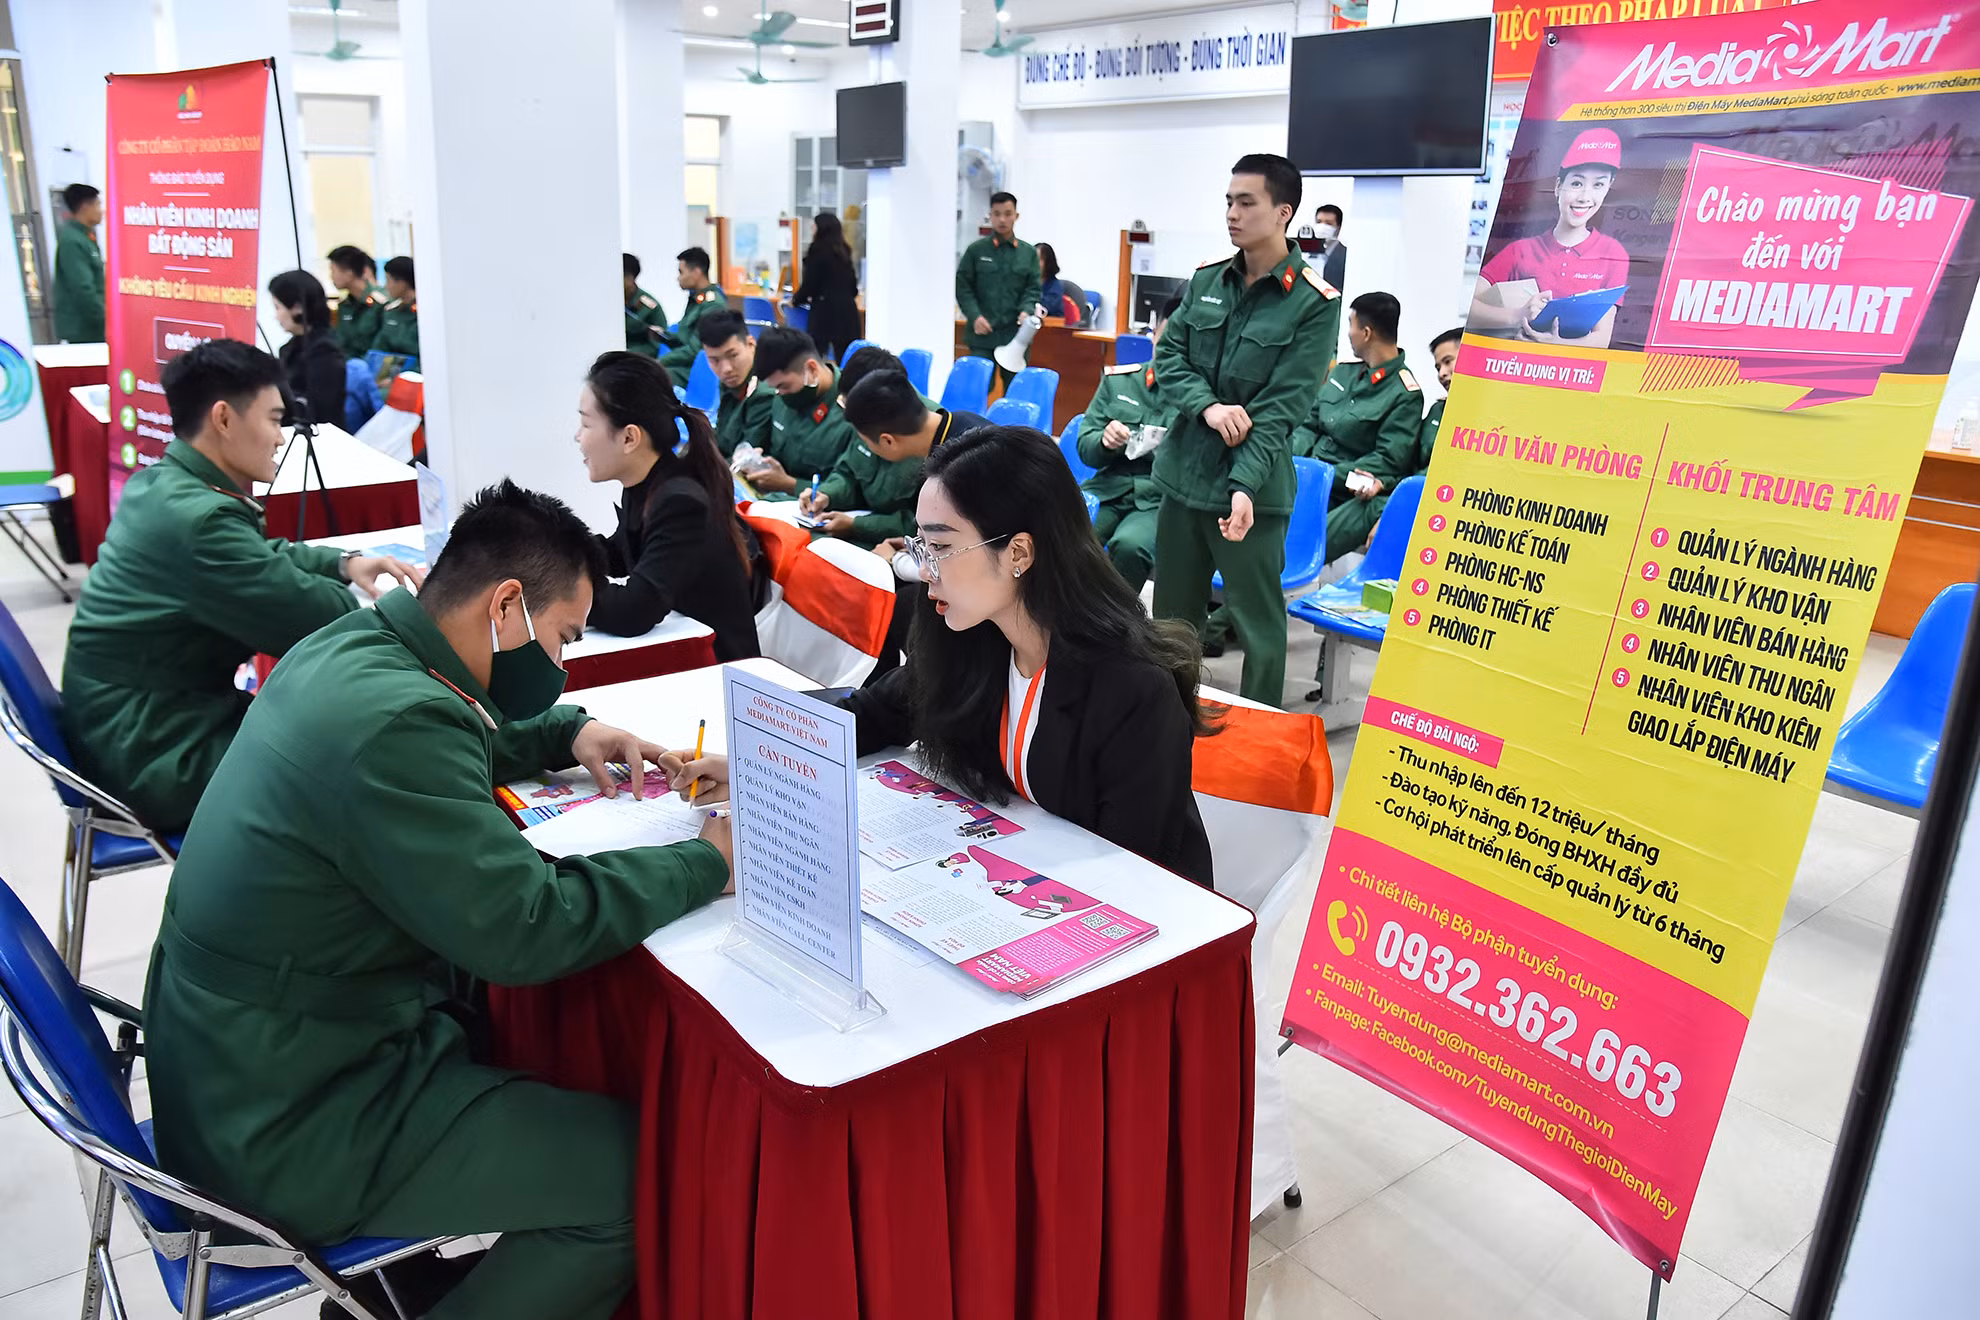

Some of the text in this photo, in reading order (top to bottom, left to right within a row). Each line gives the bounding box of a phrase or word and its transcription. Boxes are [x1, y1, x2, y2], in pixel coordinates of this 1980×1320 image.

[1605, 15, 1952, 92] Media Mart
[1581, 107, 1592, 116] Hệ
[1594, 105, 1618, 118] thống
[1619, 106, 1636, 114] hơn
[1637, 104, 1655, 113] 300
[1675, 103, 1687, 112] thị
[1688, 102, 1709, 111] Điện
[1712, 99, 1732, 110] Máy
[1733, 96, 1788, 107] MediaMart
[1788, 94, 1809, 106] phủ
[1811, 92, 1834, 103] sóng
[1836, 88, 1859, 98] toàn
[1861, 83, 1888, 96] quốc
[1697, 180, 1938, 232] Chào mừng bạn
[1742, 231, 1845, 270] đến với
[1670, 279, 1913, 334] MEDIAMART
[1485, 356, 1594, 384] TUYỂN DỤNG VỊ TRÍ:
[1451, 426, 1643, 480] KHỐI VĂN PHÒNG
[1462, 488, 1609, 536] PHÒNG KINH DOANH
[1667, 459, 1900, 522] KHỐI TRUNG TÂM
[1445, 552, 1545, 594] PHÒNG HC-NS
[1453, 520, 1570, 564] PHÒNG KẾ TOÁN
[1678, 528, 1877, 591] QUẢN LÝ NGÀNH HÀNG
[1436, 583, 1560, 632] PHÒNG THIẾT KẾ
[1668, 565, 1832, 625] QUẢN LÝ KHO VẬN
[1428, 615, 1496, 650] PHÒNG IT
[1657, 603, 1848, 672] NHÂN VIÊN BÁN HÀNG
[1647, 639, 1836, 712] NHÂN VIÊN THU NGÂN
[1391, 711, 1479, 754] CHẾ ĐỘ ĐÃI NGỘ:
[1637, 675, 1822, 752] NHÂN VIÊN KHO KIÊM
[1628, 710, 1796, 784] GIAO LẮP ĐIỆN MÁY
[1399, 745, 1660, 866] Thu nhập lên đến 12 triệu/ tháng
[1390, 772, 1679, 903] Đào tạo kỹ năng, Đóng BHXH đầy đủ
[1383, 798, 1725, 964] Cơ hội phát triển lên cấp quản lý từ 6 tháng
[1350, 867, 1619, 1010] Chi tiết liên hệ Bộ phận tuyển dụng:
[1375, 921, 1682, 1117] 0932.362.663
[1321, 963, 1614, 1139] Email: Tuyendung@mediamart.com.vn
[1314, 989, 1678, 1220] Fanpage: Facebook.com/TuyendungThegioiDienMay
